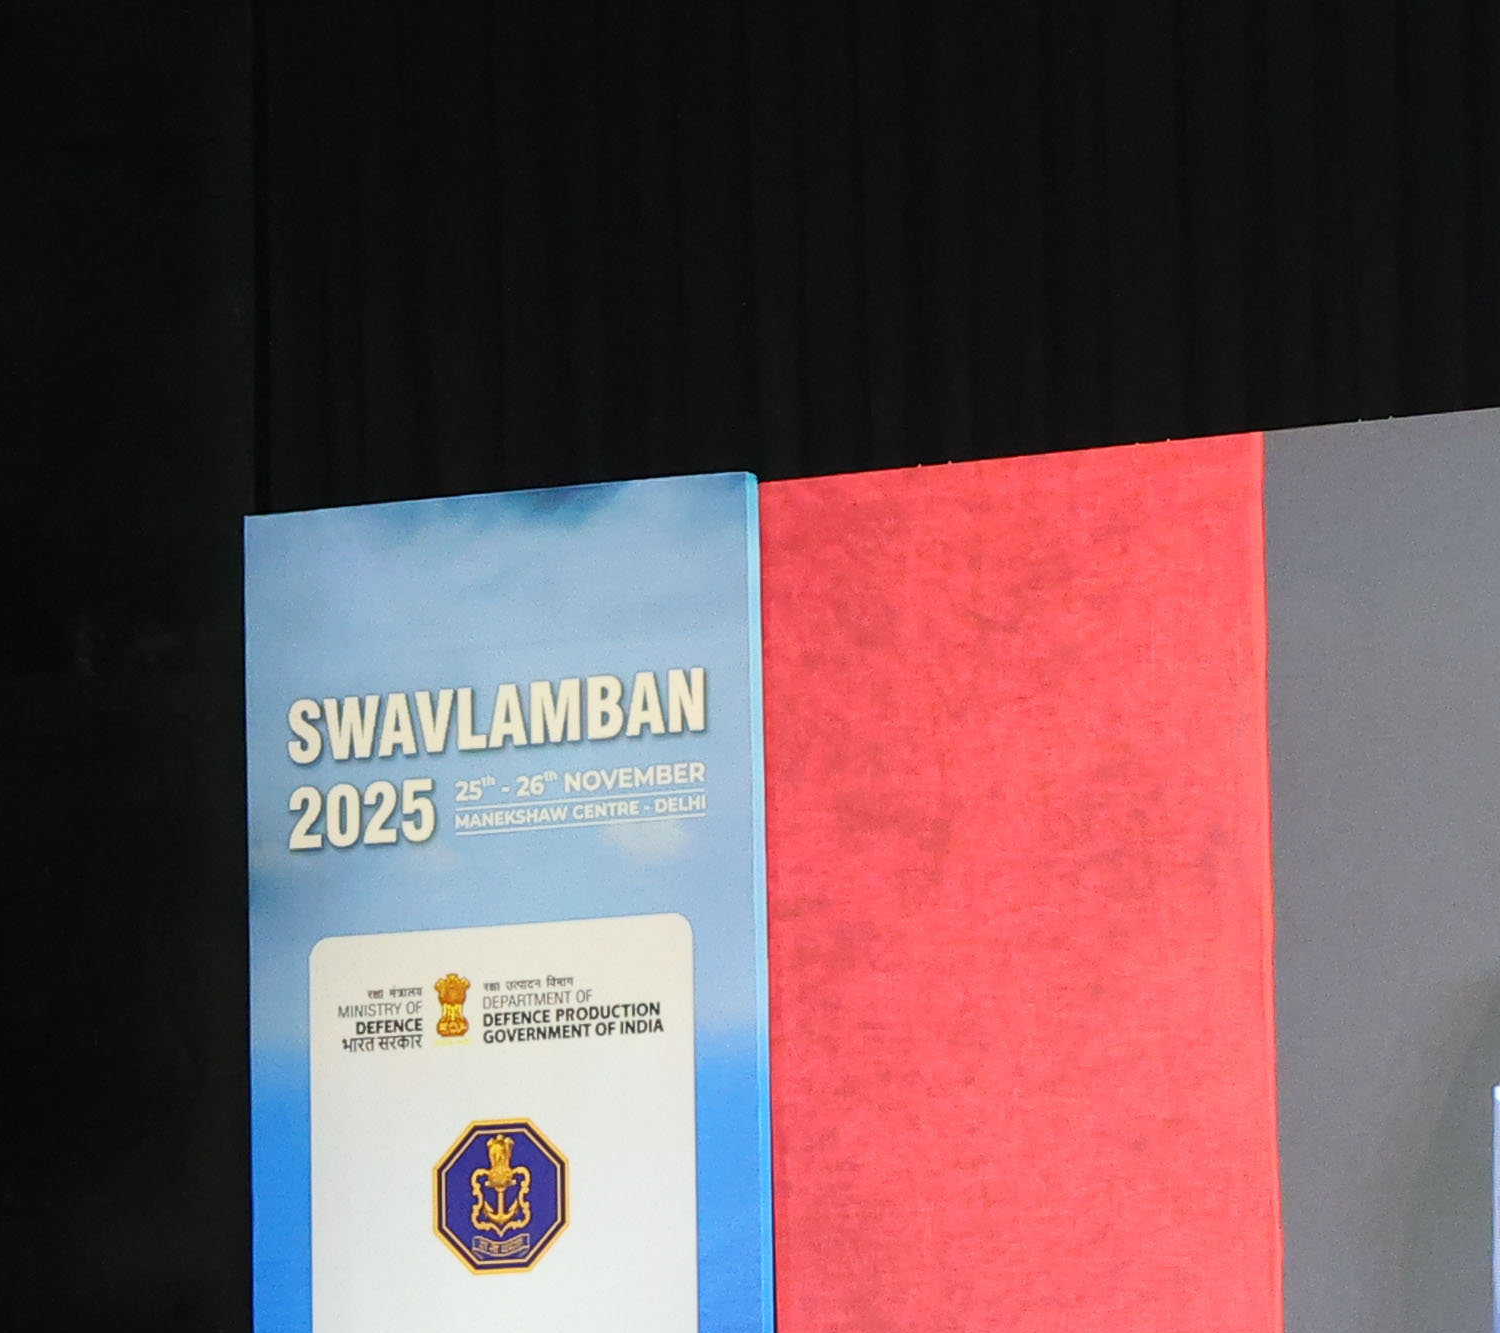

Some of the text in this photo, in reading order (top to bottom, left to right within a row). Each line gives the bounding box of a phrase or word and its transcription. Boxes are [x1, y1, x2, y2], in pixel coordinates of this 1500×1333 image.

[287, 667, 706, 765] SWAVLAMBAN
[455, 774, 496, 802] 25th
[516, 770, 559, 798] 26th
[564, 761, 707, 793] NOVEMBER
[288, 777, 437, 851] 2025
[455, 806, 568, 830] MANEKSHAW
[572, 799, 640, 820] CENTRE
[655, 794, 707, 814] DELHI
[337, 1000, 423, 1019] MINISTRY OF
[482, 988, 593, 1010] DEPARTMENT OF
[355, 1018, 423, 1036] DEFENCE
[483, 1001, 661, 1027] DEFENCE PRODUCTION
[342, 1037, 375, 1053] भारत
[378, 1034, 423, 1050] सरकार
[483, 1023, 592, 1044] GOVERNMENT
[595, 1021, 616, 1037] OF
[620, 1018, 664, 1035] INDIA
